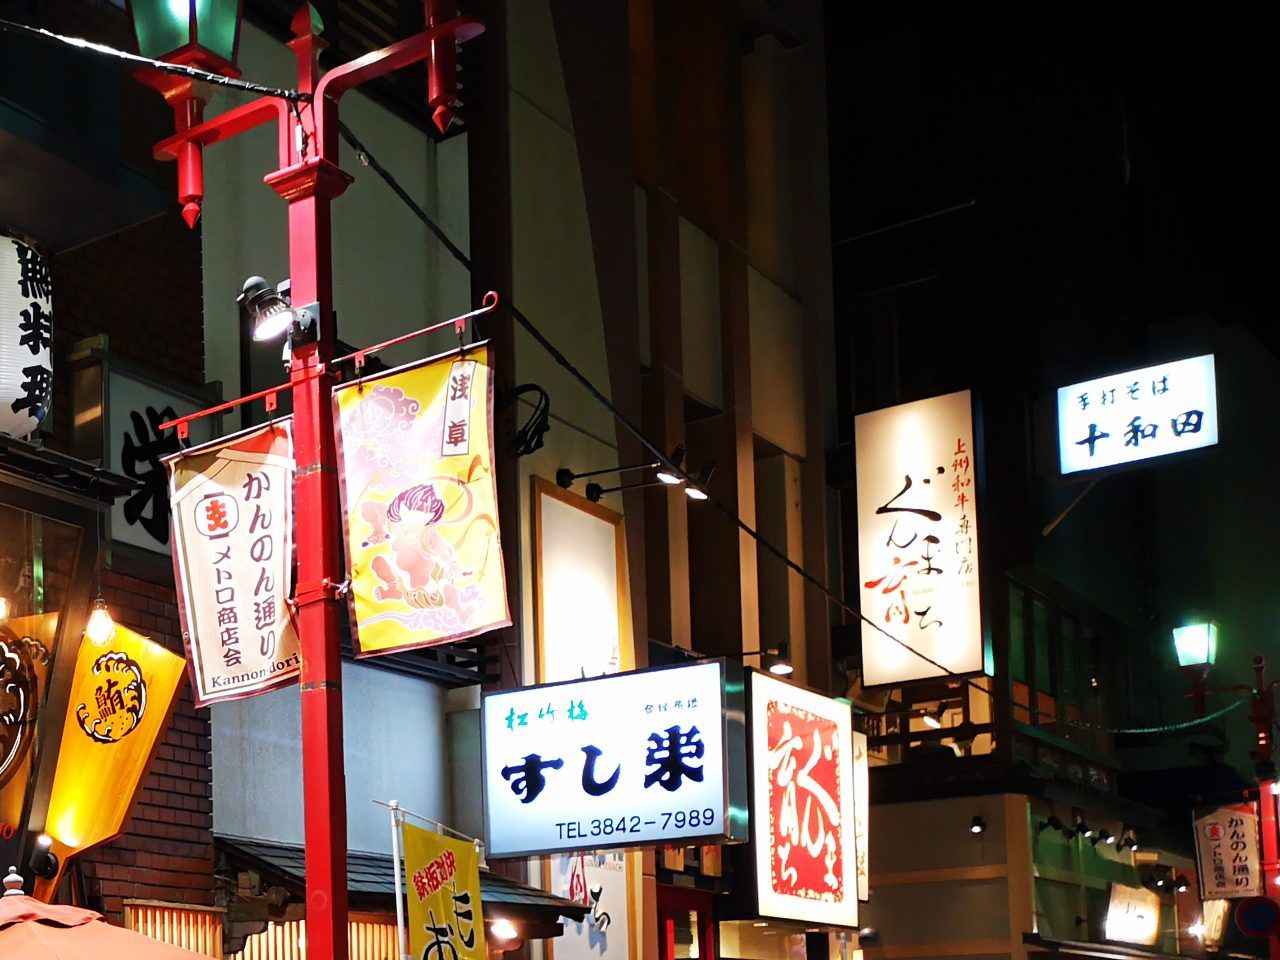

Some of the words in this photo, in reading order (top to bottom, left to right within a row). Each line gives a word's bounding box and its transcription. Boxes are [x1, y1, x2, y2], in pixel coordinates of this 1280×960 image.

[446, 373, 470, 447] 浅草
[1077, 374, 1170, 411] 手打そば
[1075, 409, 1204, 457] 十和田
[951, 438, 975, 576] 上州和牛専門店
[242, 471, 277, 660] かんのん通り
[210, 544, 244, 667] メトロ商店会
[501, 724, 705, 804] すし栄
[1228, 817, 1251, 887] かんのん通り
